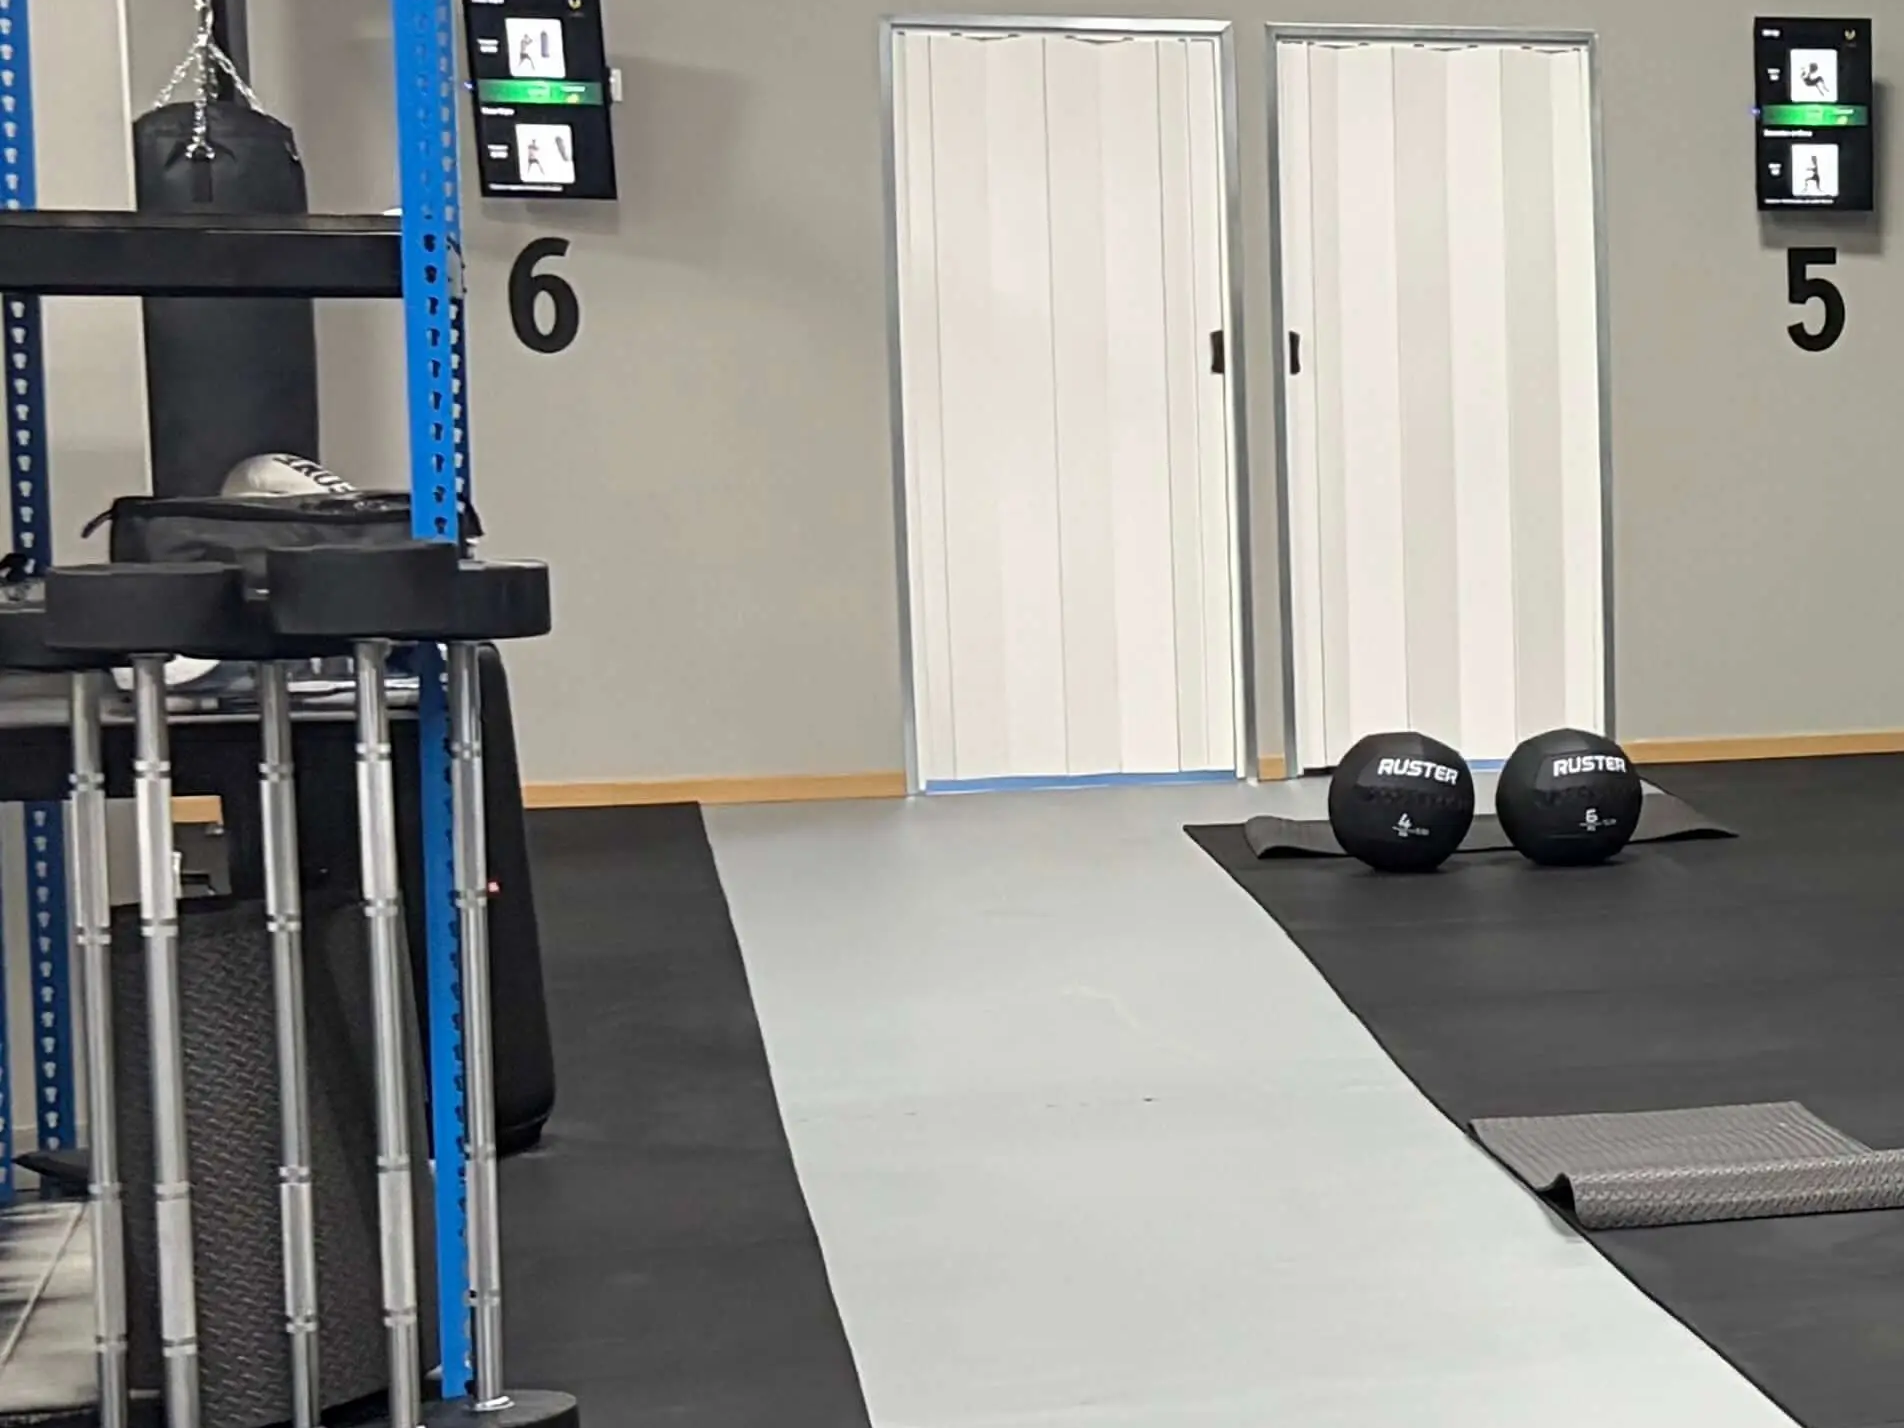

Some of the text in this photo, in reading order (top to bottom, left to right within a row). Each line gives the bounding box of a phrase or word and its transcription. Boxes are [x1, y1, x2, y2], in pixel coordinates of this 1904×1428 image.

[508, 236, 581, 354] 6
[1787, 247, 1845, 352] 5
[1377, 757, 1459, 785] RUSTER
[1553, 754, 1627, 777] RUSTER
